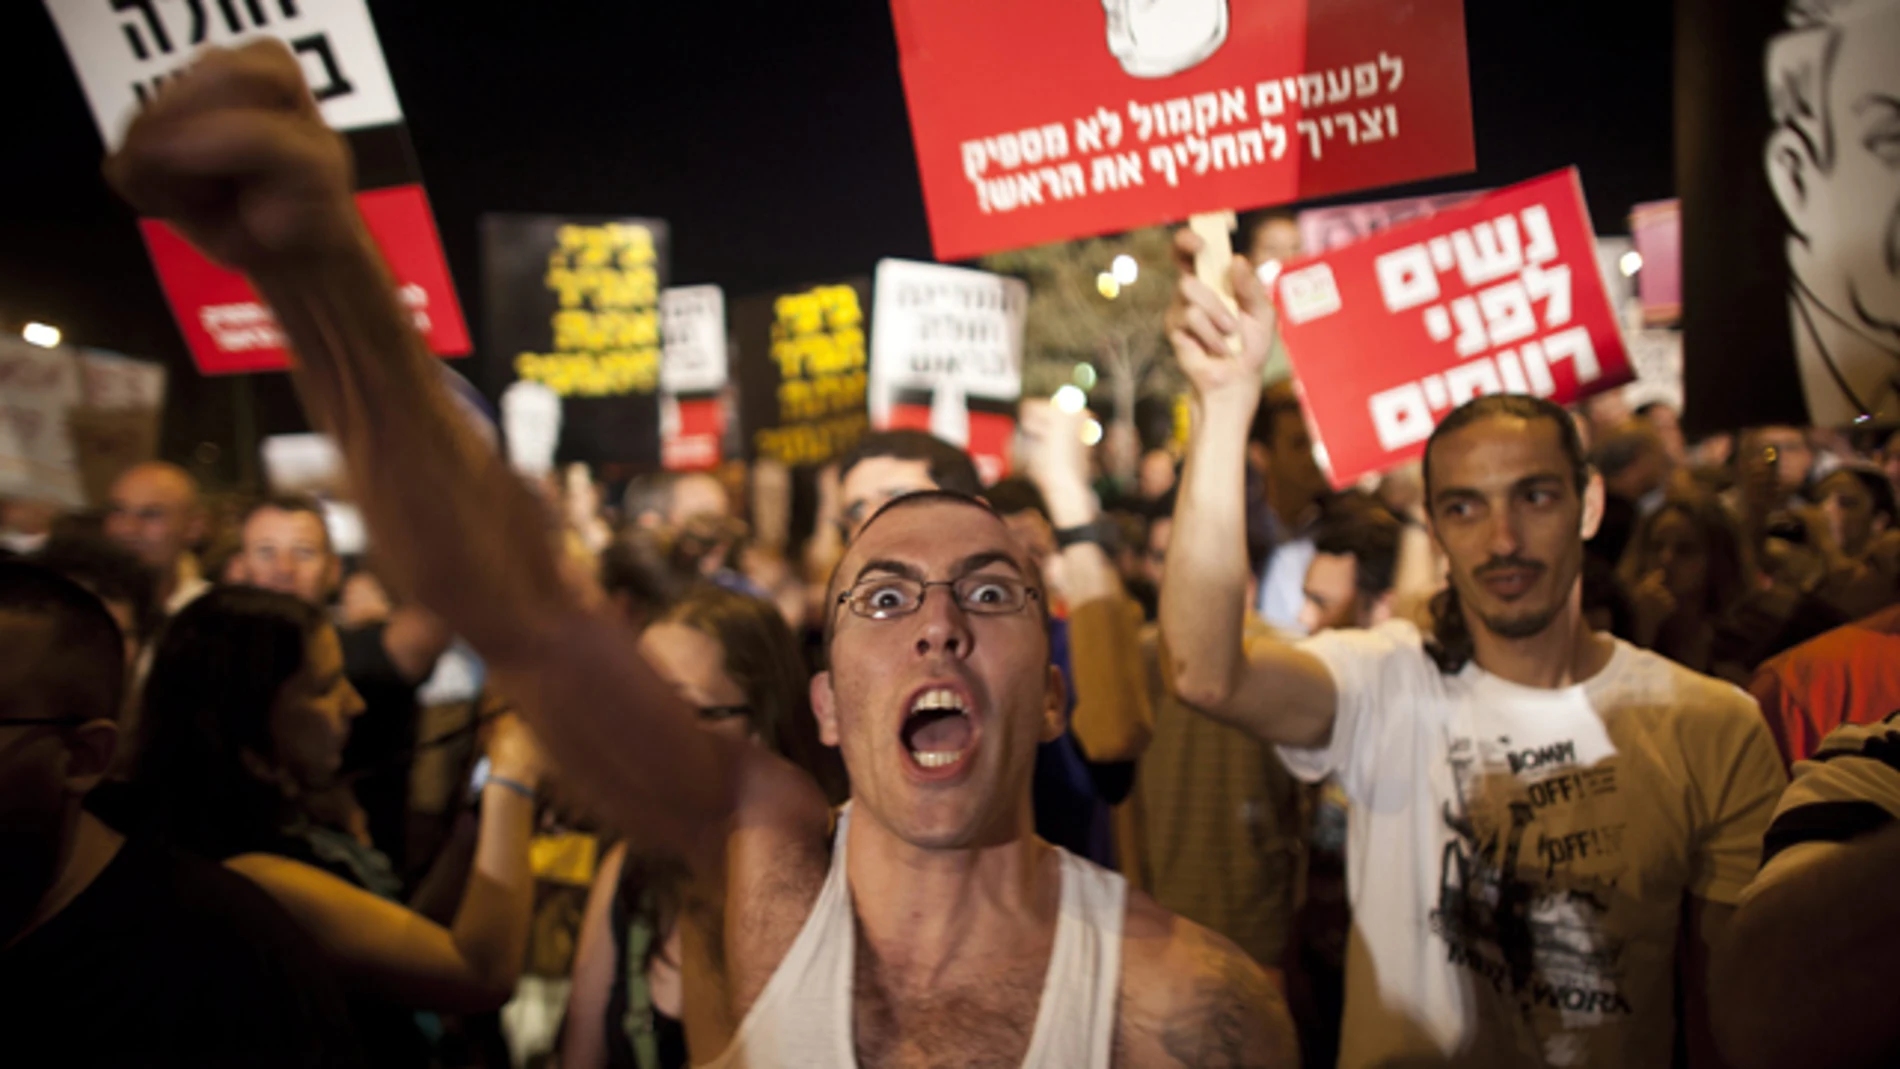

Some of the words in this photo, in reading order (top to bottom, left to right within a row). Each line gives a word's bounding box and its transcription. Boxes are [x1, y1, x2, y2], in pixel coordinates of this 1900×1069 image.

[1255, 51, 1404, 118] לפעמים
[1073, 105, 1123, 154] לא
[1127, 86, 1248, 142] אקמול
[1296, 103, 1398, 160] וצריך
[960, 122, 1069, 182] מספיק
[1091, 150, 1144, 194] את
[1149, 119, 1287, 187] להחליף
[975, 162, 1086, 215] הראש!
[1374, 203, 1559, 315] נשים
[1422, 262, 1573, 358] לפני
